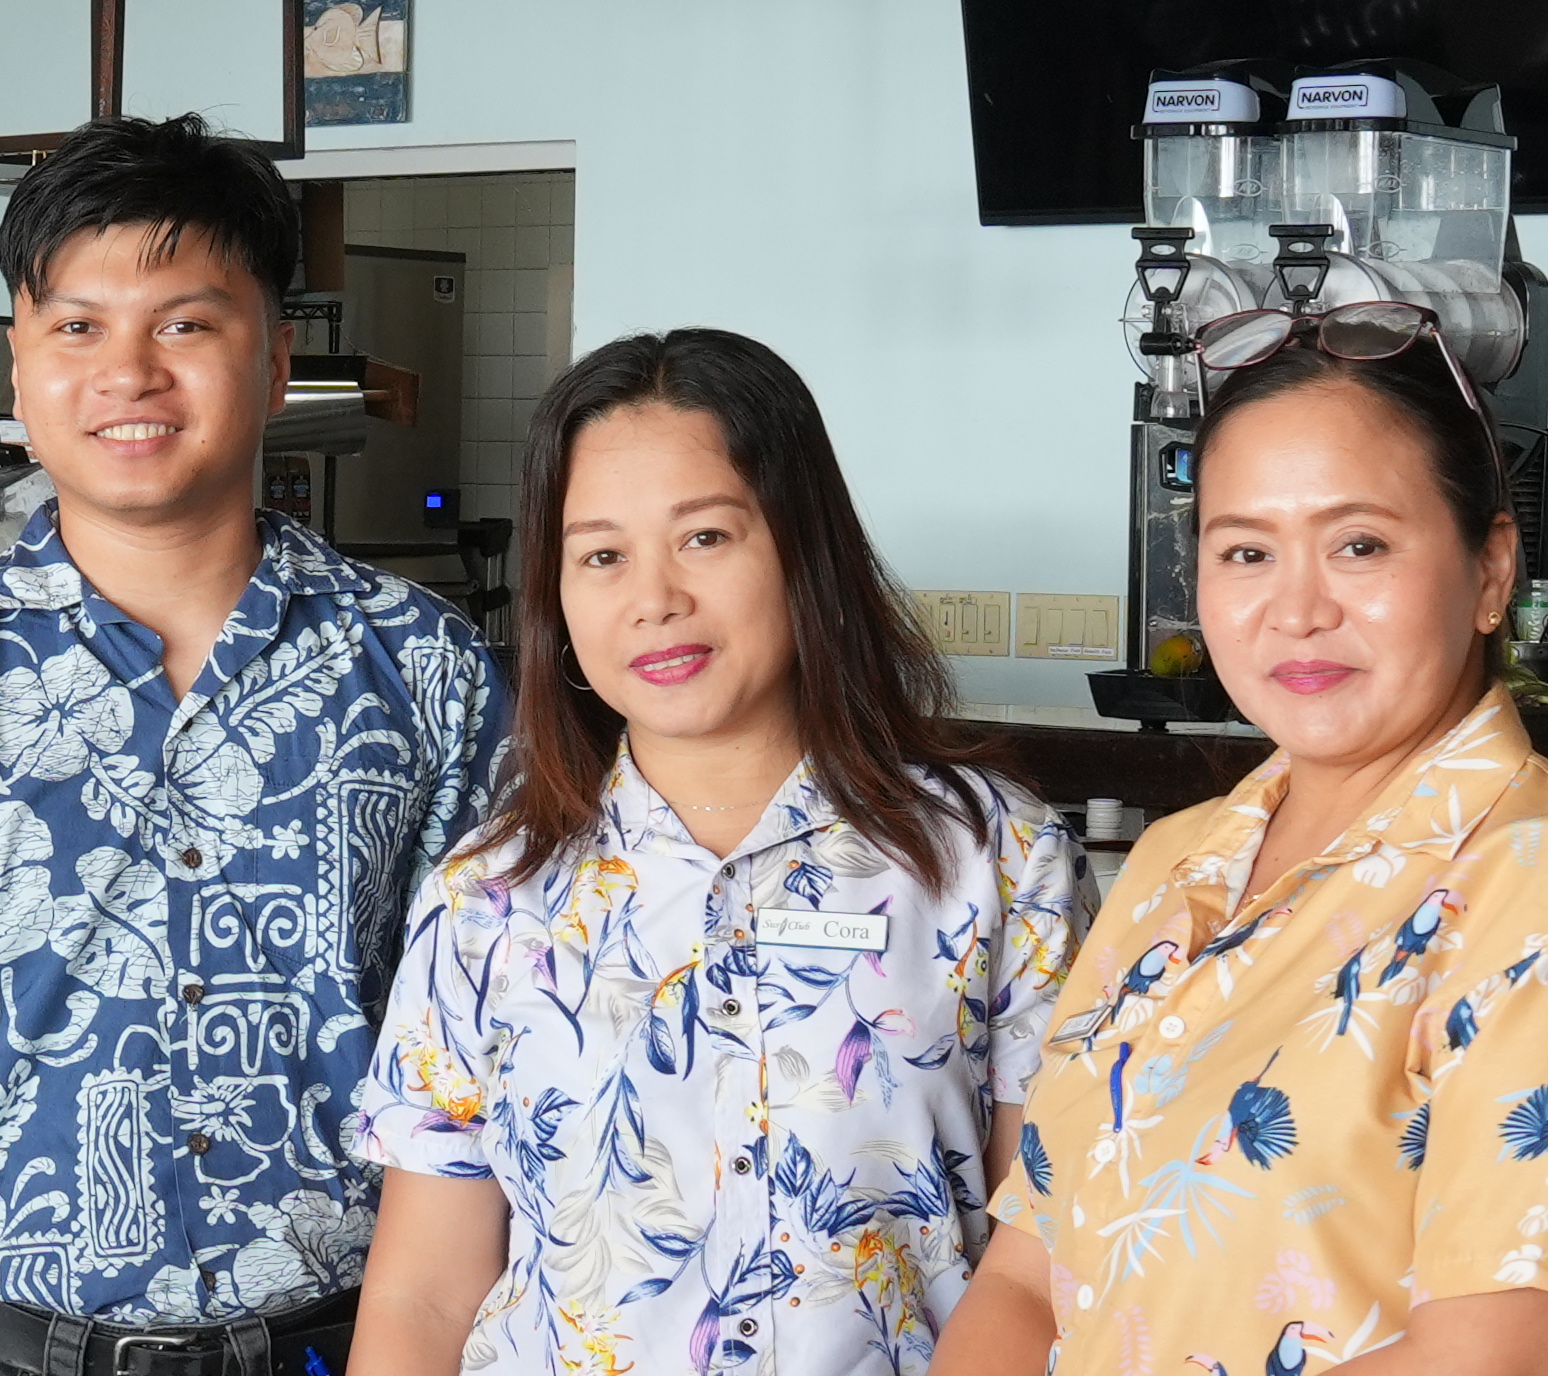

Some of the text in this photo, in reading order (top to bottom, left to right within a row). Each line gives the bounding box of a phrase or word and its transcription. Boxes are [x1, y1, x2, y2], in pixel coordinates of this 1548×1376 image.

[1156, 94, 1215, 107] NARVON
[1301, 90, 1363, 103] NARVON
[823, 920, 870, 940] Cora
